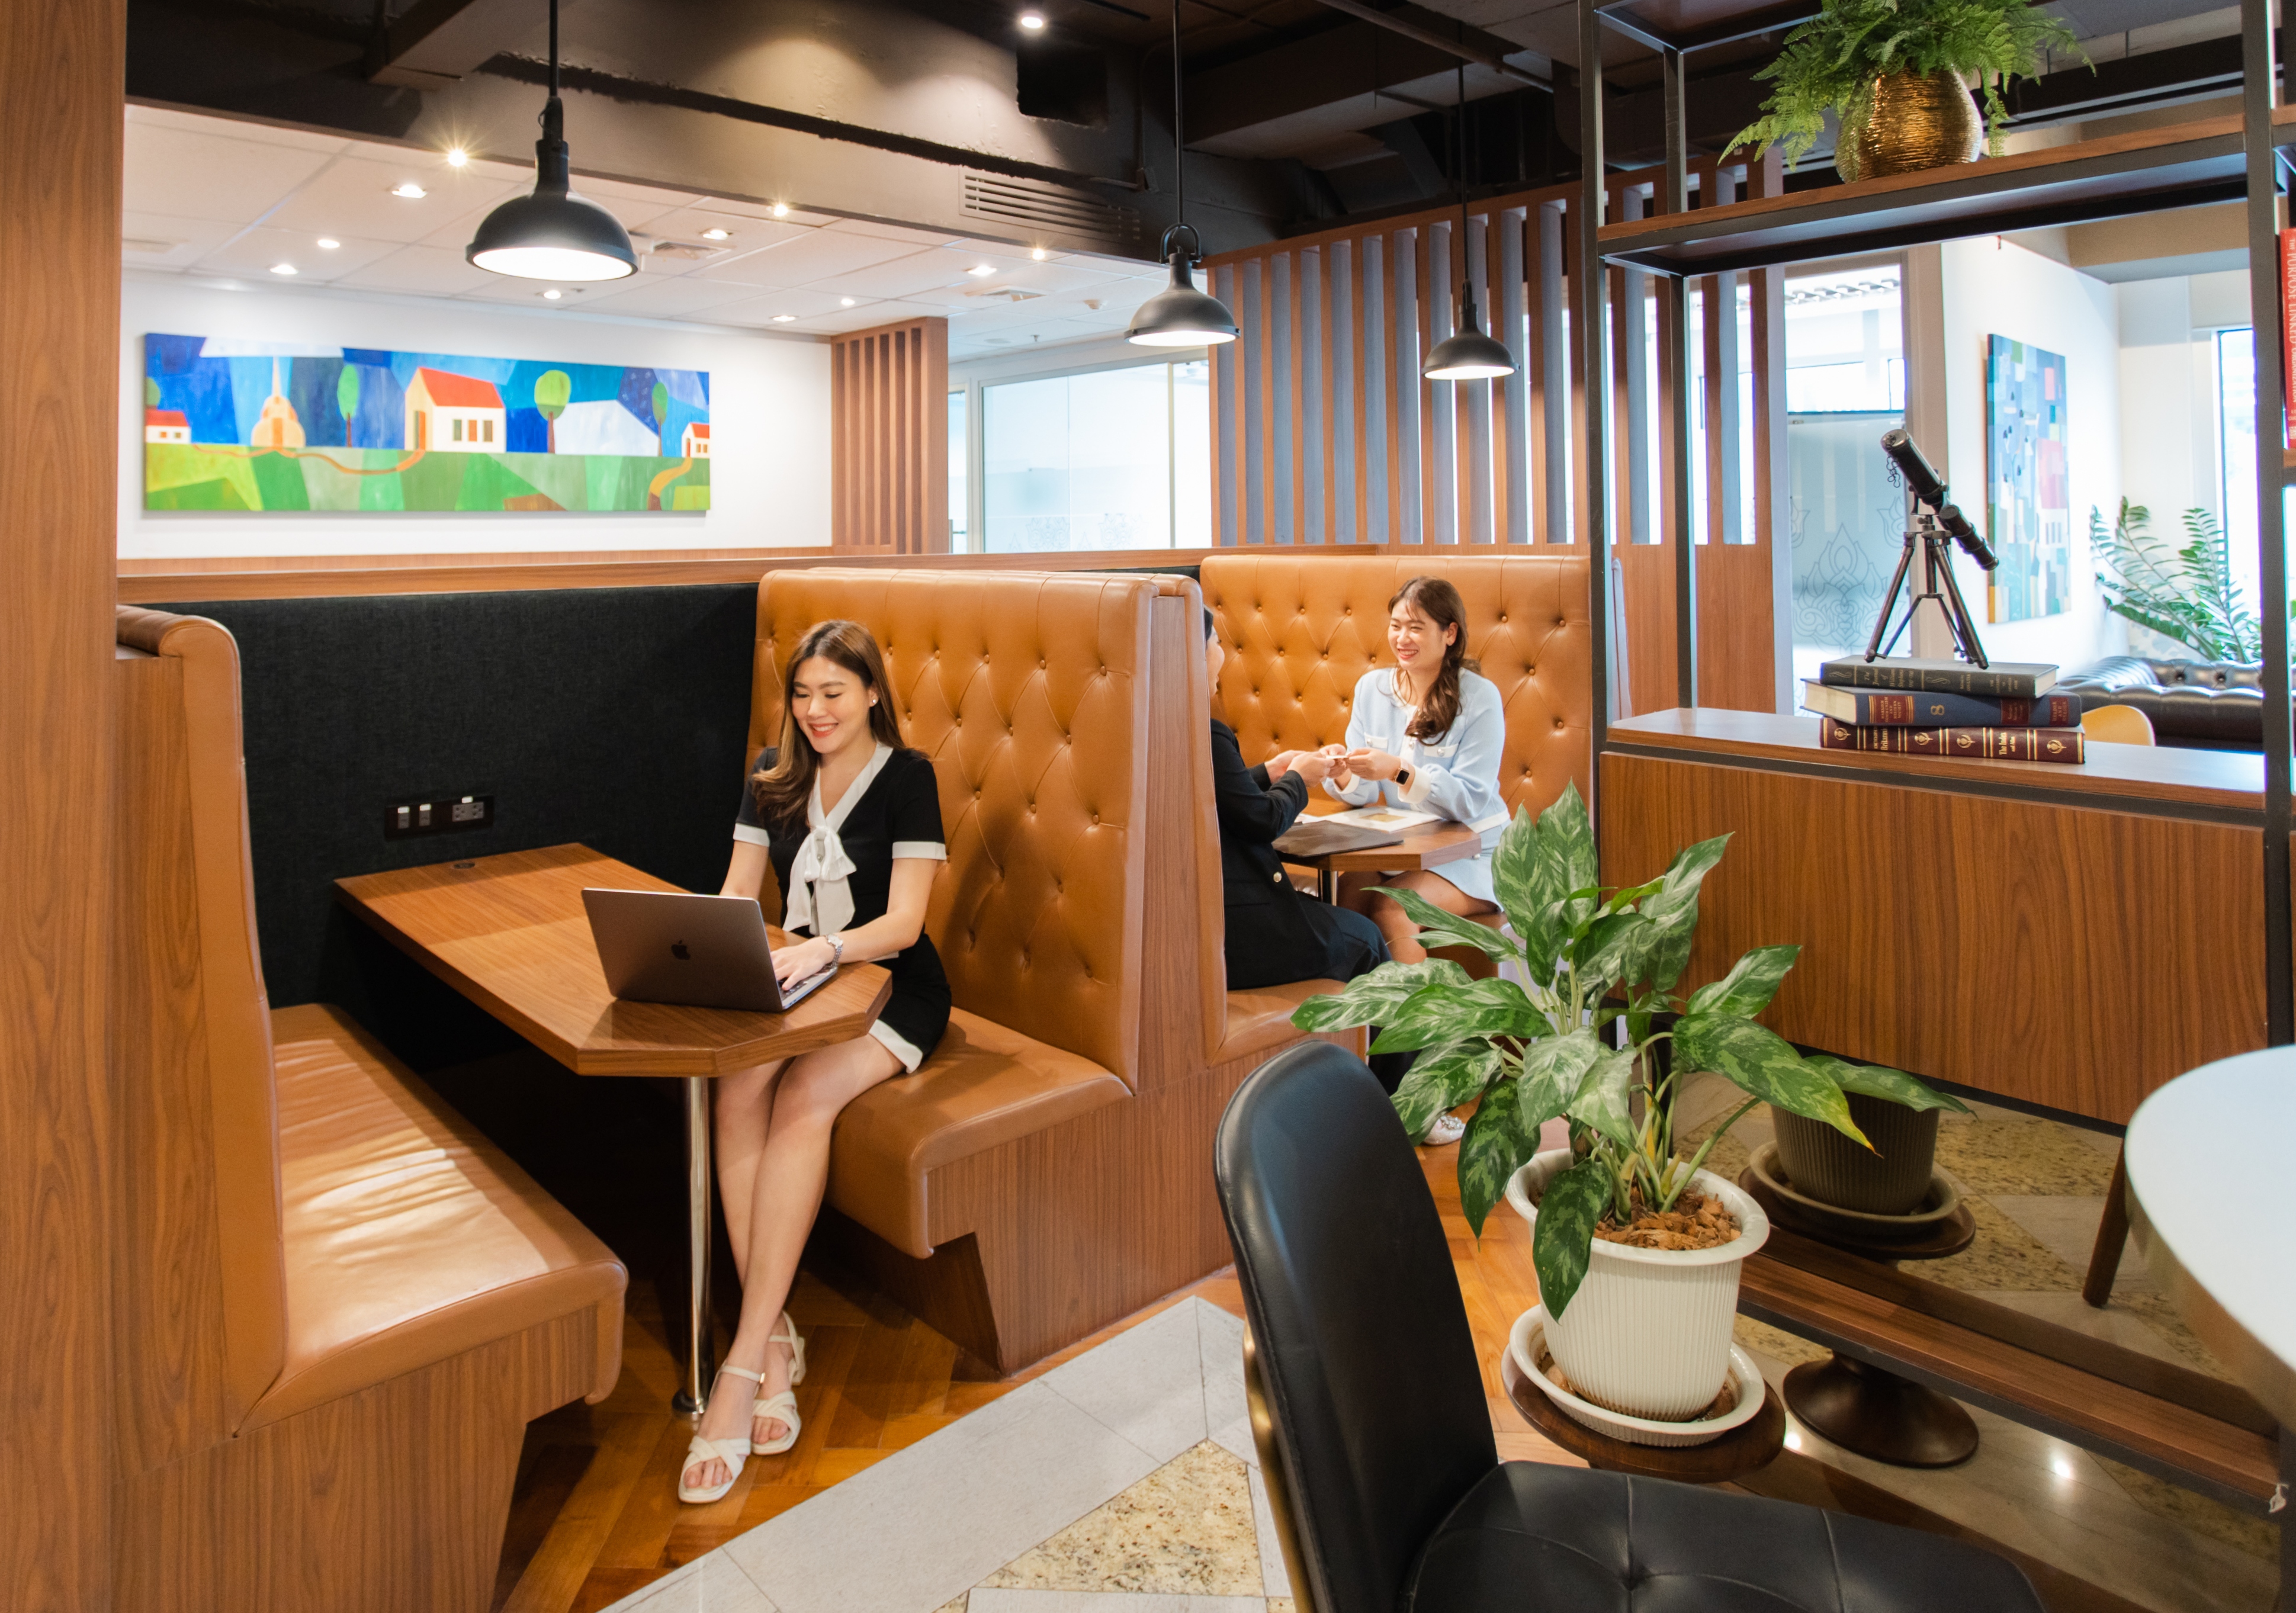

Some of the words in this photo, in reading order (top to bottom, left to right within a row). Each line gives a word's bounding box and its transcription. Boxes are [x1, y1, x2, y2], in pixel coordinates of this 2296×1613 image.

[2287, 253, 2296, 299] PURPOSE
[1931, 705, 1945, 715] 8
[1880, 727, 1889, 750] Britanni
